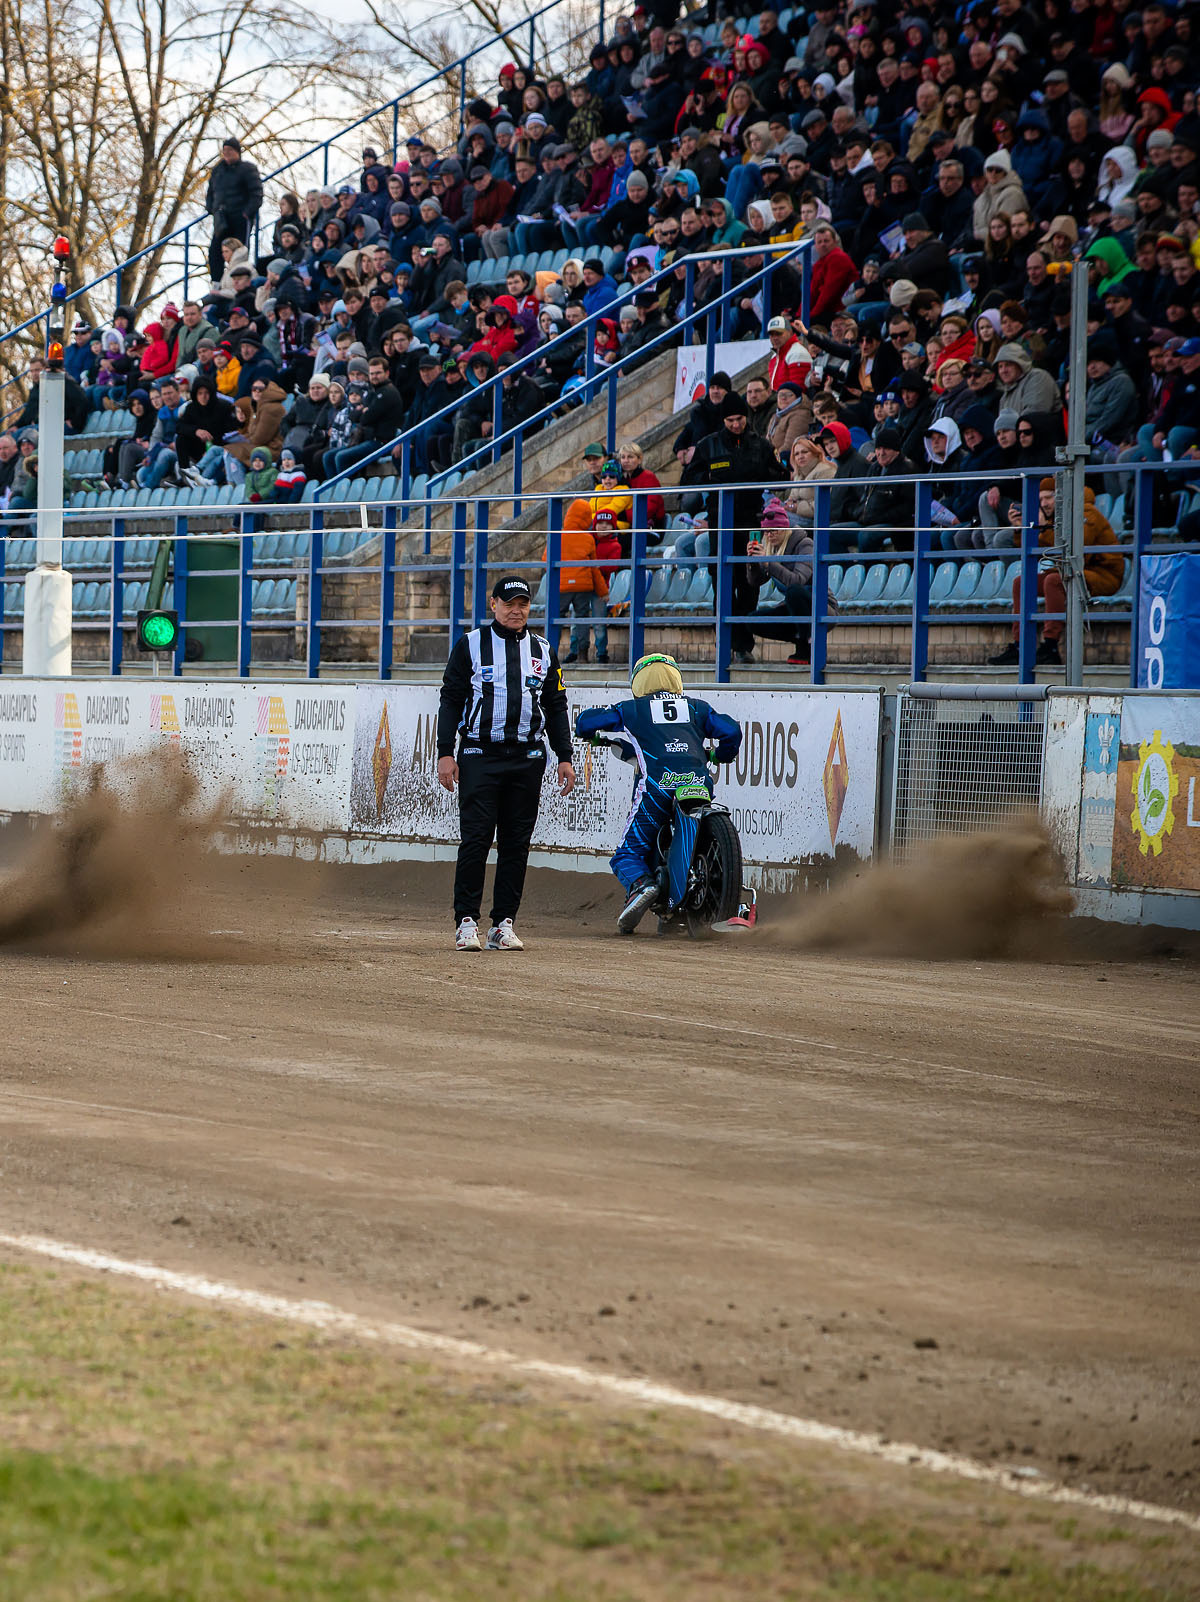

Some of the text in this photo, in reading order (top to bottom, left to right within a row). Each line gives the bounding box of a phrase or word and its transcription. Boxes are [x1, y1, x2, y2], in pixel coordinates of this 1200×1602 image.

[85, 696, 130, 725] DAUGAVPILS
[184, 697, 234, 728] DAUGAVPILS
[294, 699, 346, 731] DAUGAVPILS
[662, 700, 678, 722] 5
